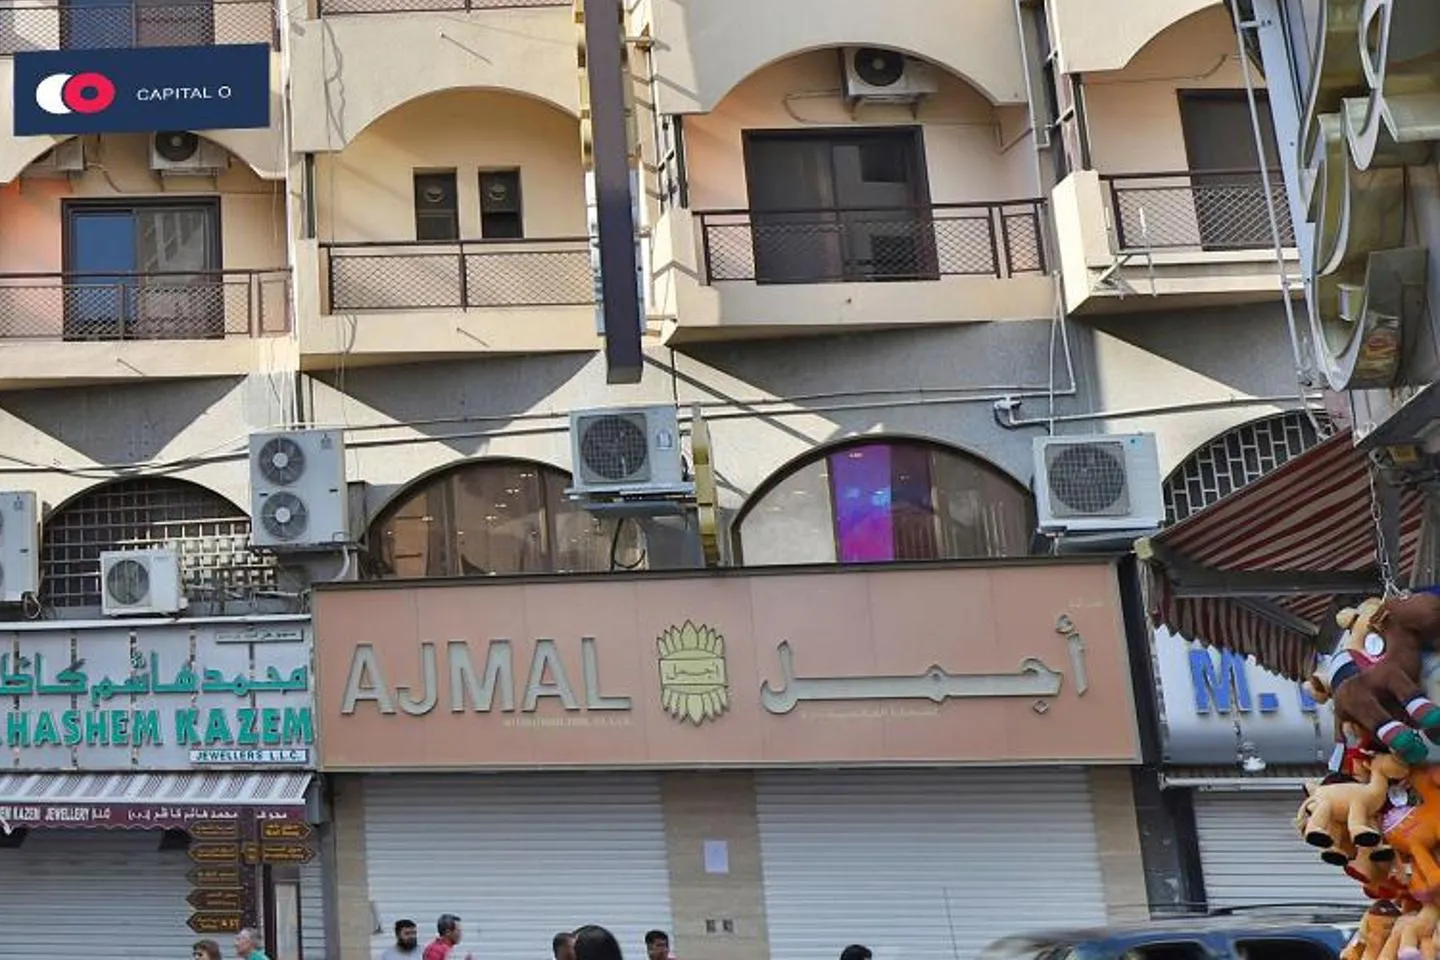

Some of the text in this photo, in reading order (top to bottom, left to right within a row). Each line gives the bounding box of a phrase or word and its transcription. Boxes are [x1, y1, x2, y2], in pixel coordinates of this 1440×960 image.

[137, 85, 232, 101] CAPITAL O
[341, 636, 633, 716] AJMAL
[174, 705, 314, 747] KAZEM
[45, 807, 90, 821] JEWELLERY
